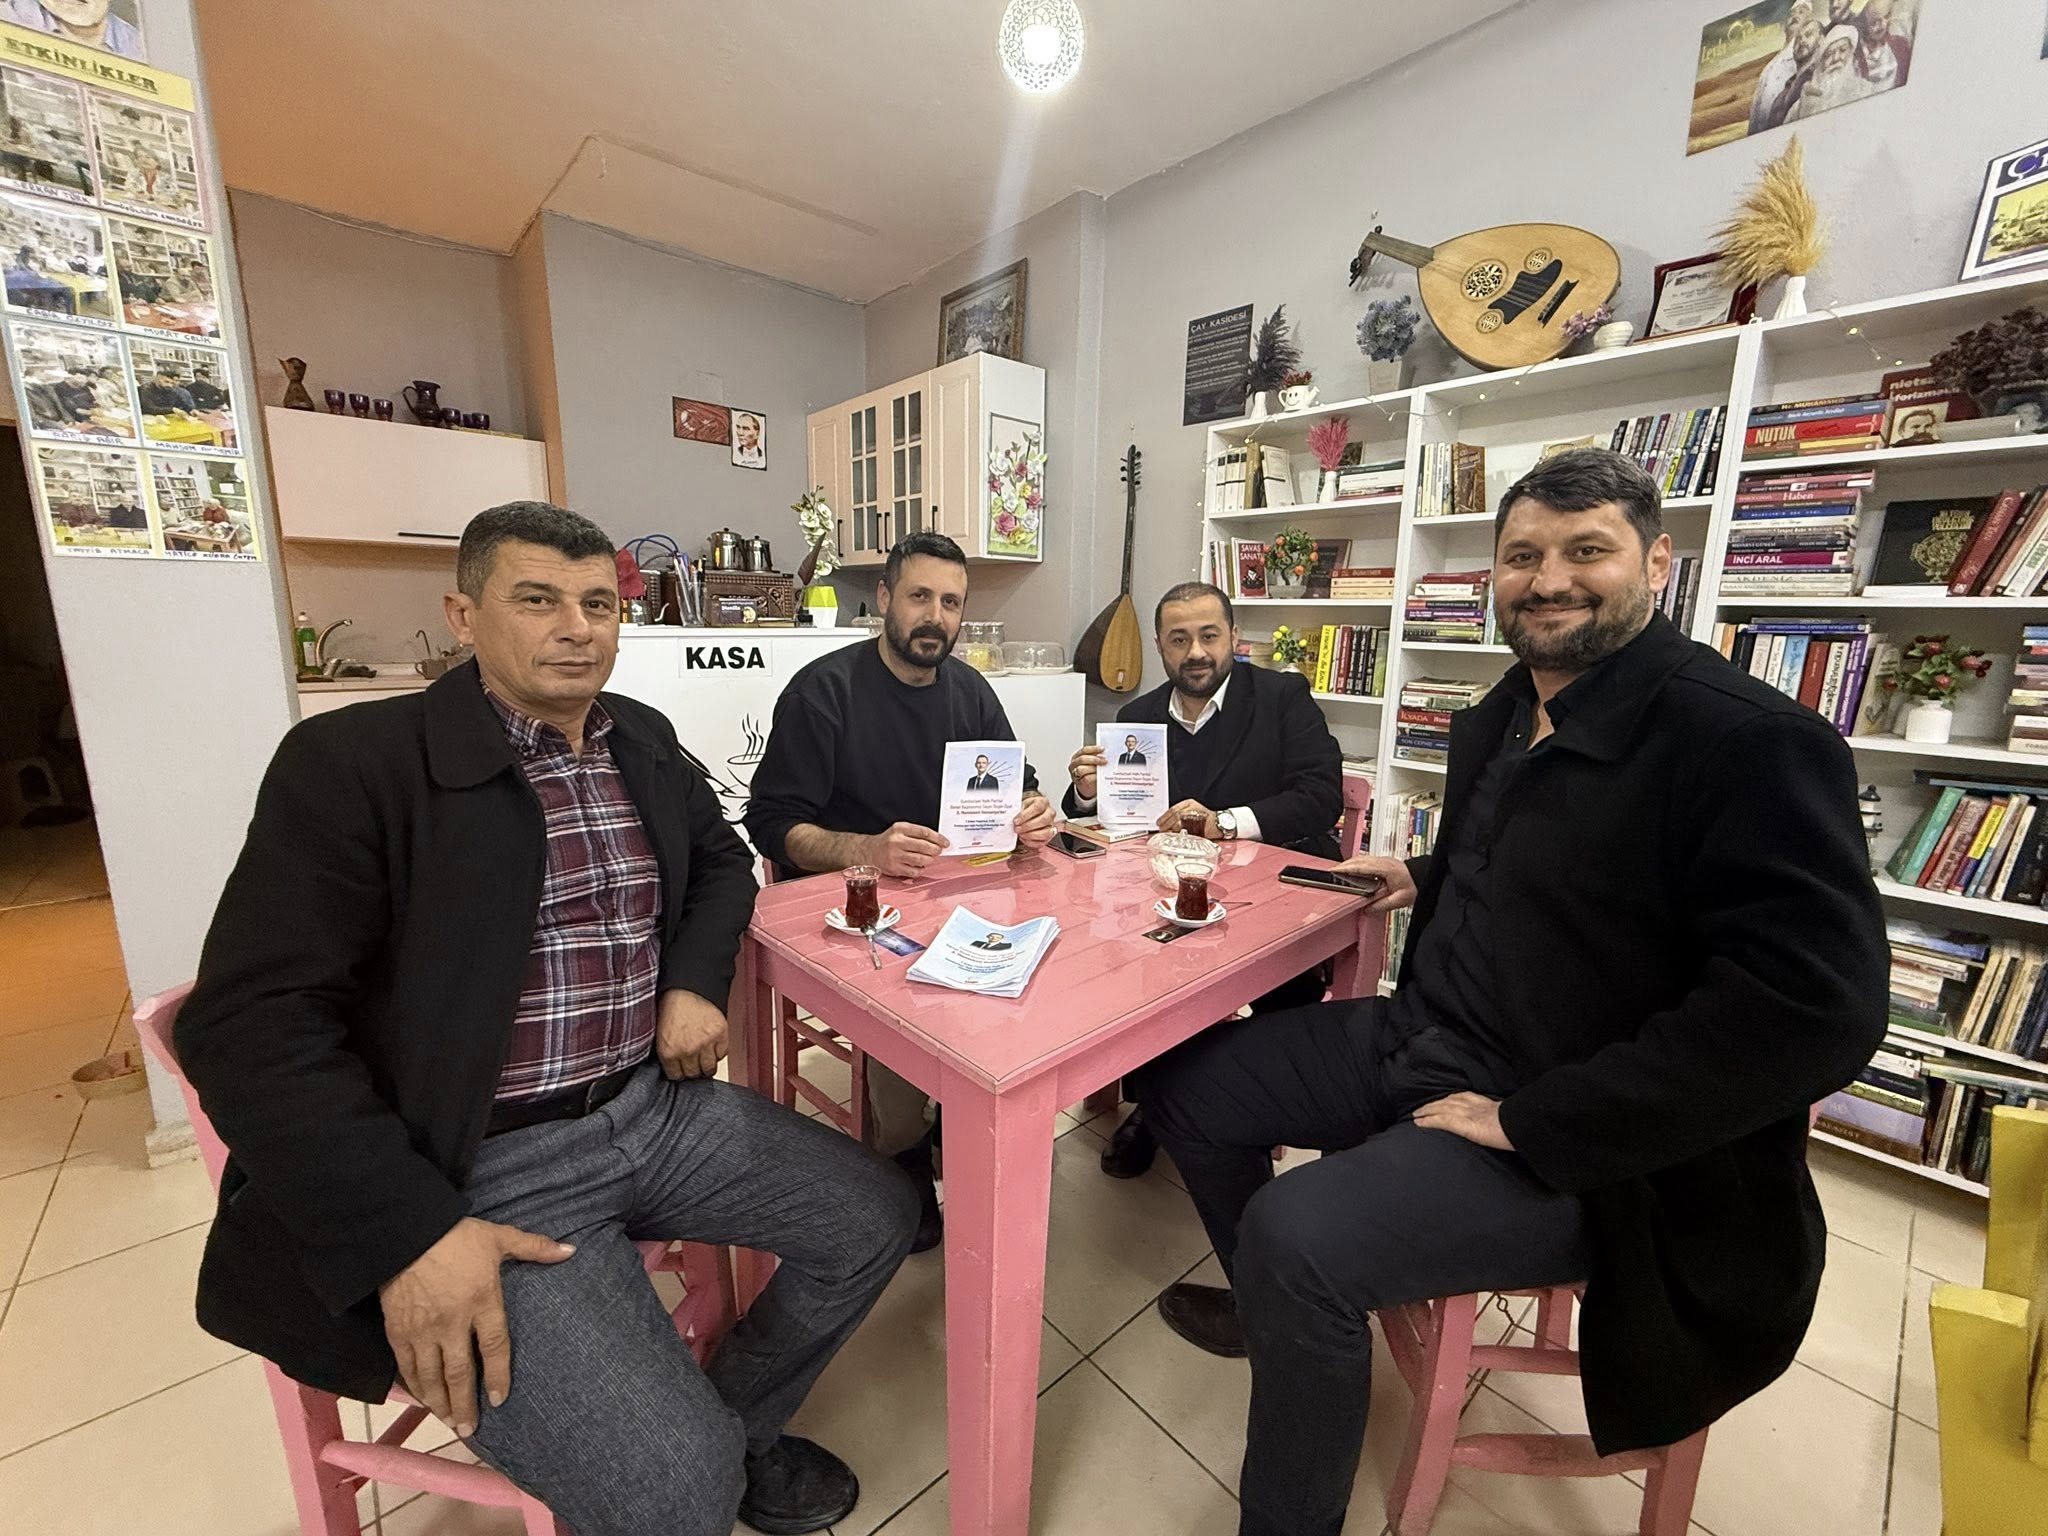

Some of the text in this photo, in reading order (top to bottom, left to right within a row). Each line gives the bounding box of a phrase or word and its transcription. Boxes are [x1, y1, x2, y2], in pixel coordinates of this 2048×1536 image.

[5, 36, 157, 92] ETKİNLİKLER
[1190, 309, 1247, 334] ÇAY KASİDESİ
[143, 327, 179, 339] MURAT
[1755, 425, 1797, 444] NUTUK
[1782, 491, 1815, 501] Haben
[1732, 554, 1784, 564] İNCİ ARAL
[686, 646, 766, 669] KASA
